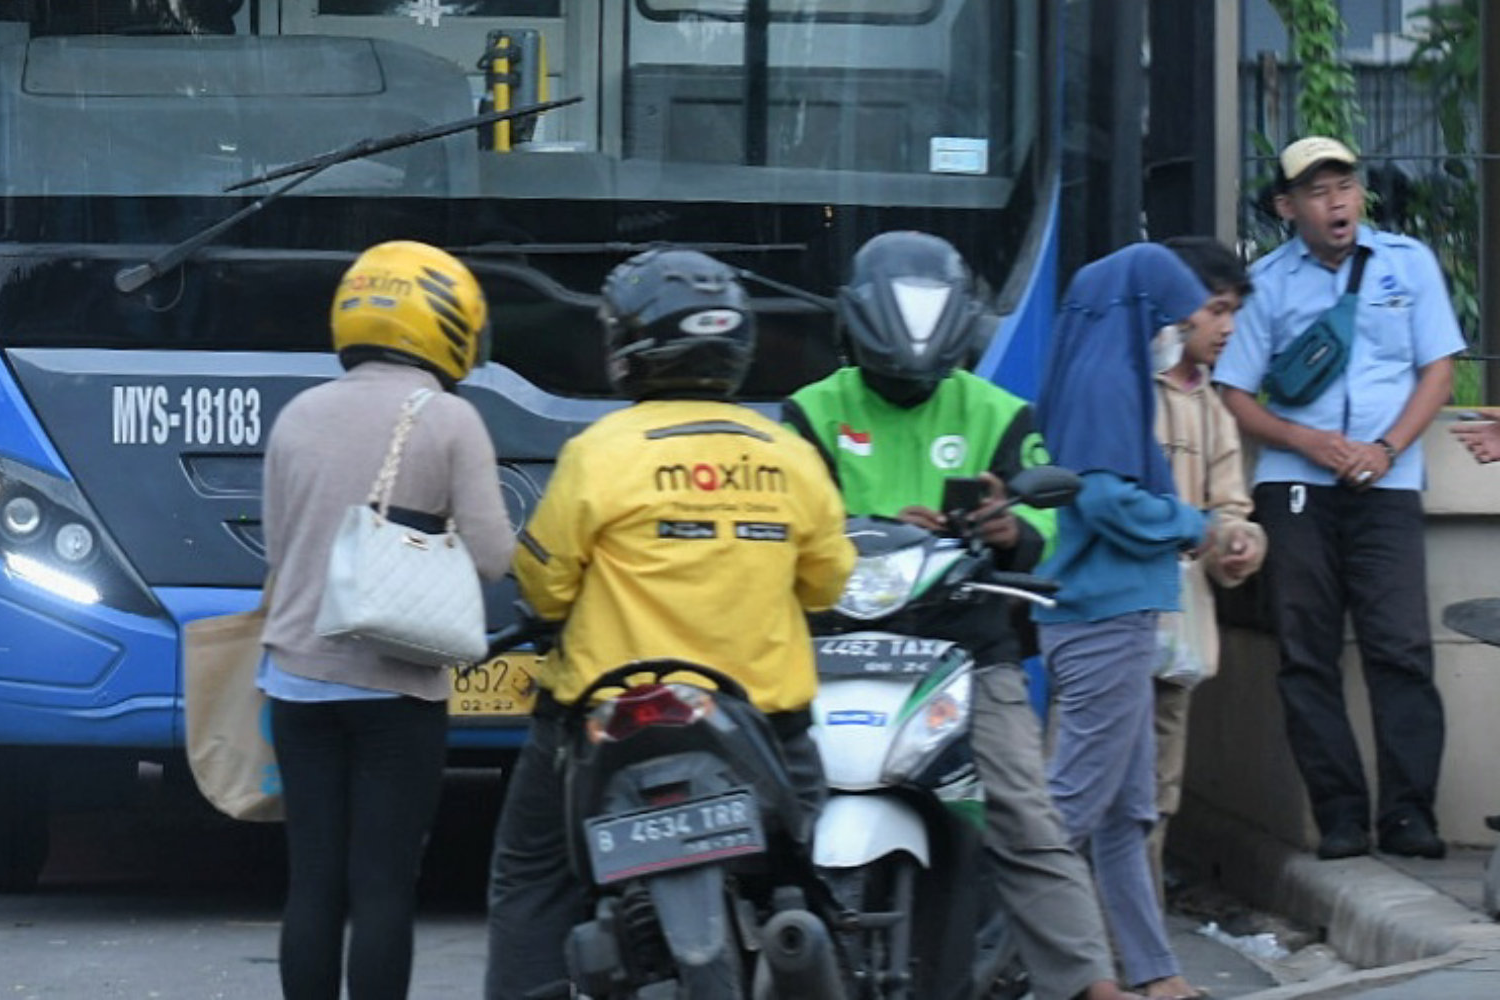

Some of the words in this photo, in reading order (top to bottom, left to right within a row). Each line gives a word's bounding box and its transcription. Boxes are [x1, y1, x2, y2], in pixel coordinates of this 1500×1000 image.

[113, 385, 261, 446] MYS-18183
[655, 455, 787, 493] maxim
[630, 813, 692, 842] 4634
